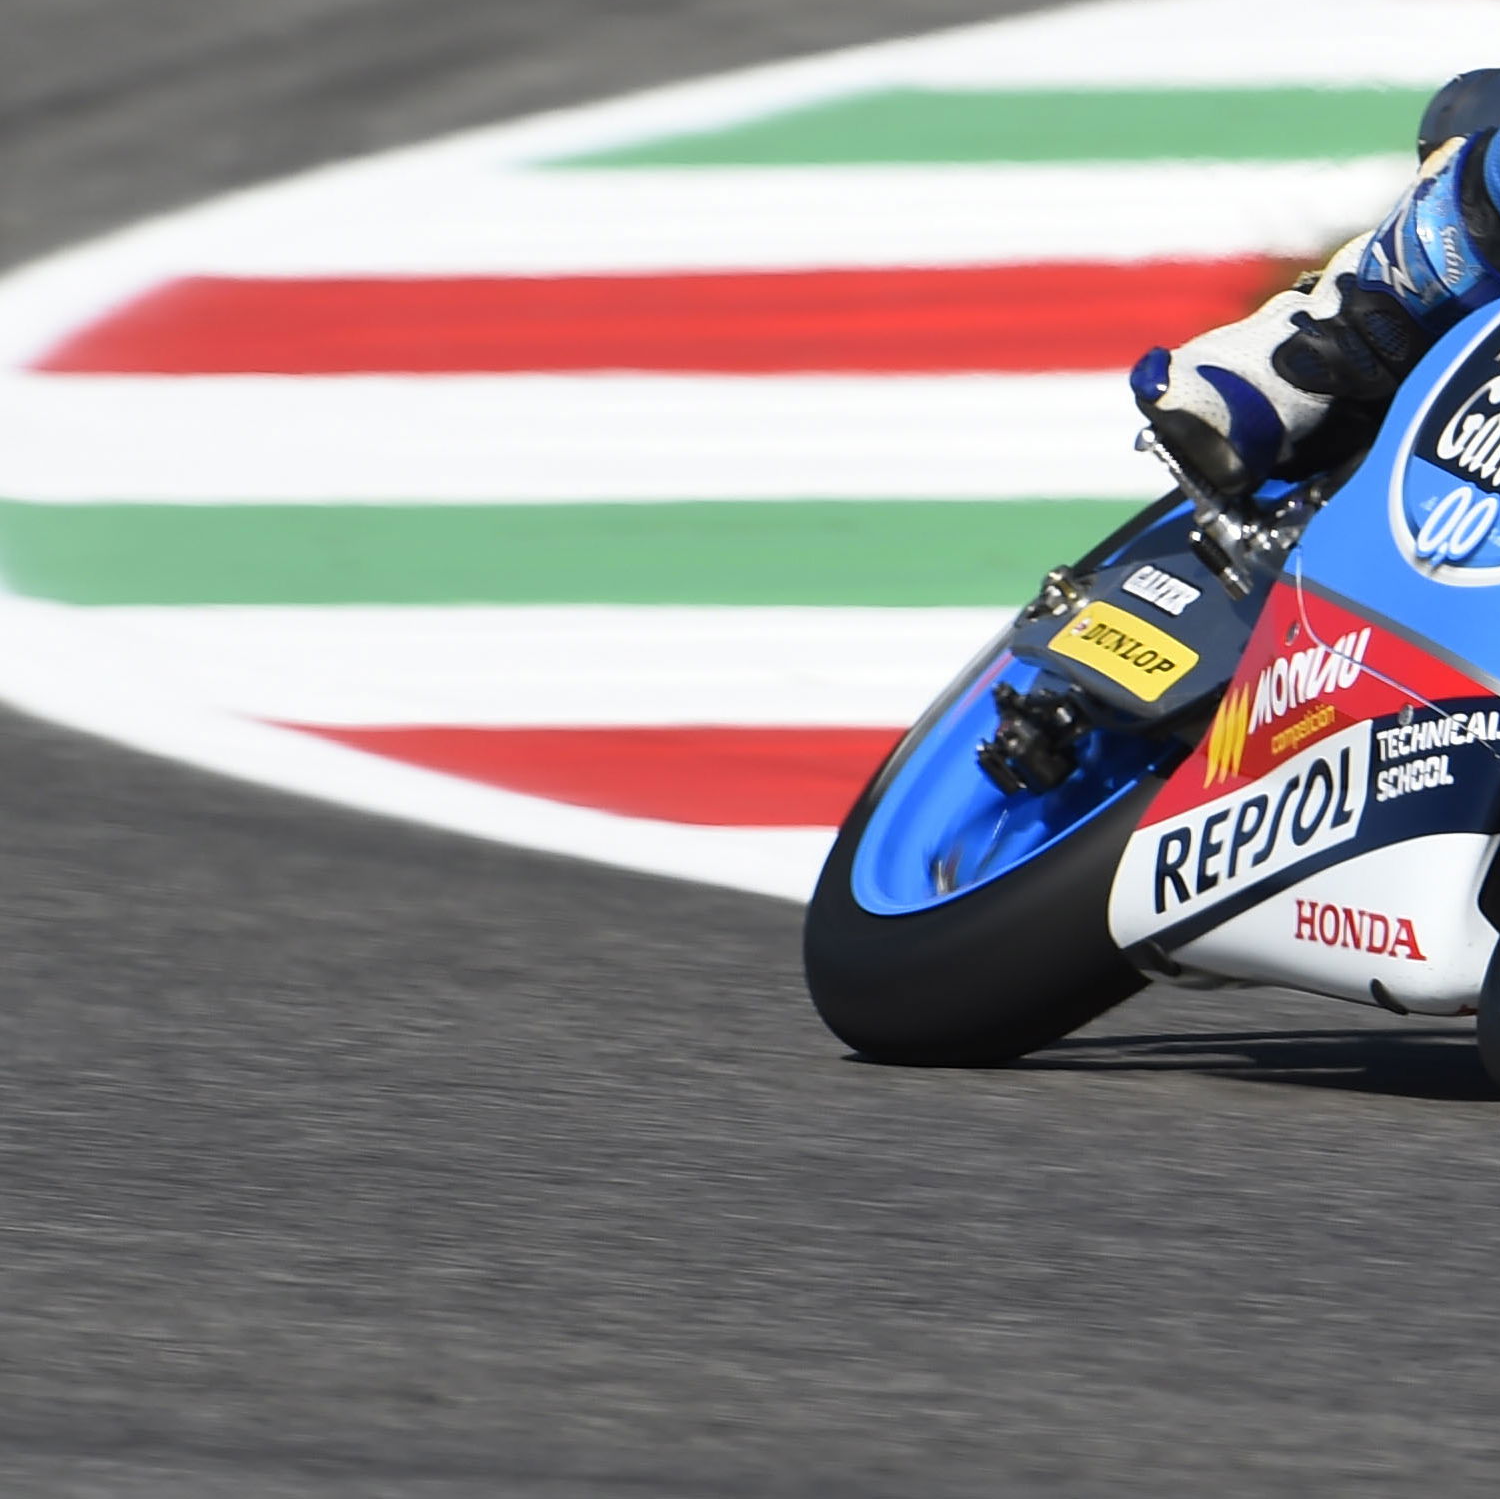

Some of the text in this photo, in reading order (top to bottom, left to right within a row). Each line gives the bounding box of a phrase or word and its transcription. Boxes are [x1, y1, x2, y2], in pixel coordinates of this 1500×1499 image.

[1081, 623, 1176, 674] DUNLOP
[1376, 754, 1455, 803] SCHOOL
[1154, 746, 1355, 915] REPSOL
[1294, 898, 1428, 961] HONDA
